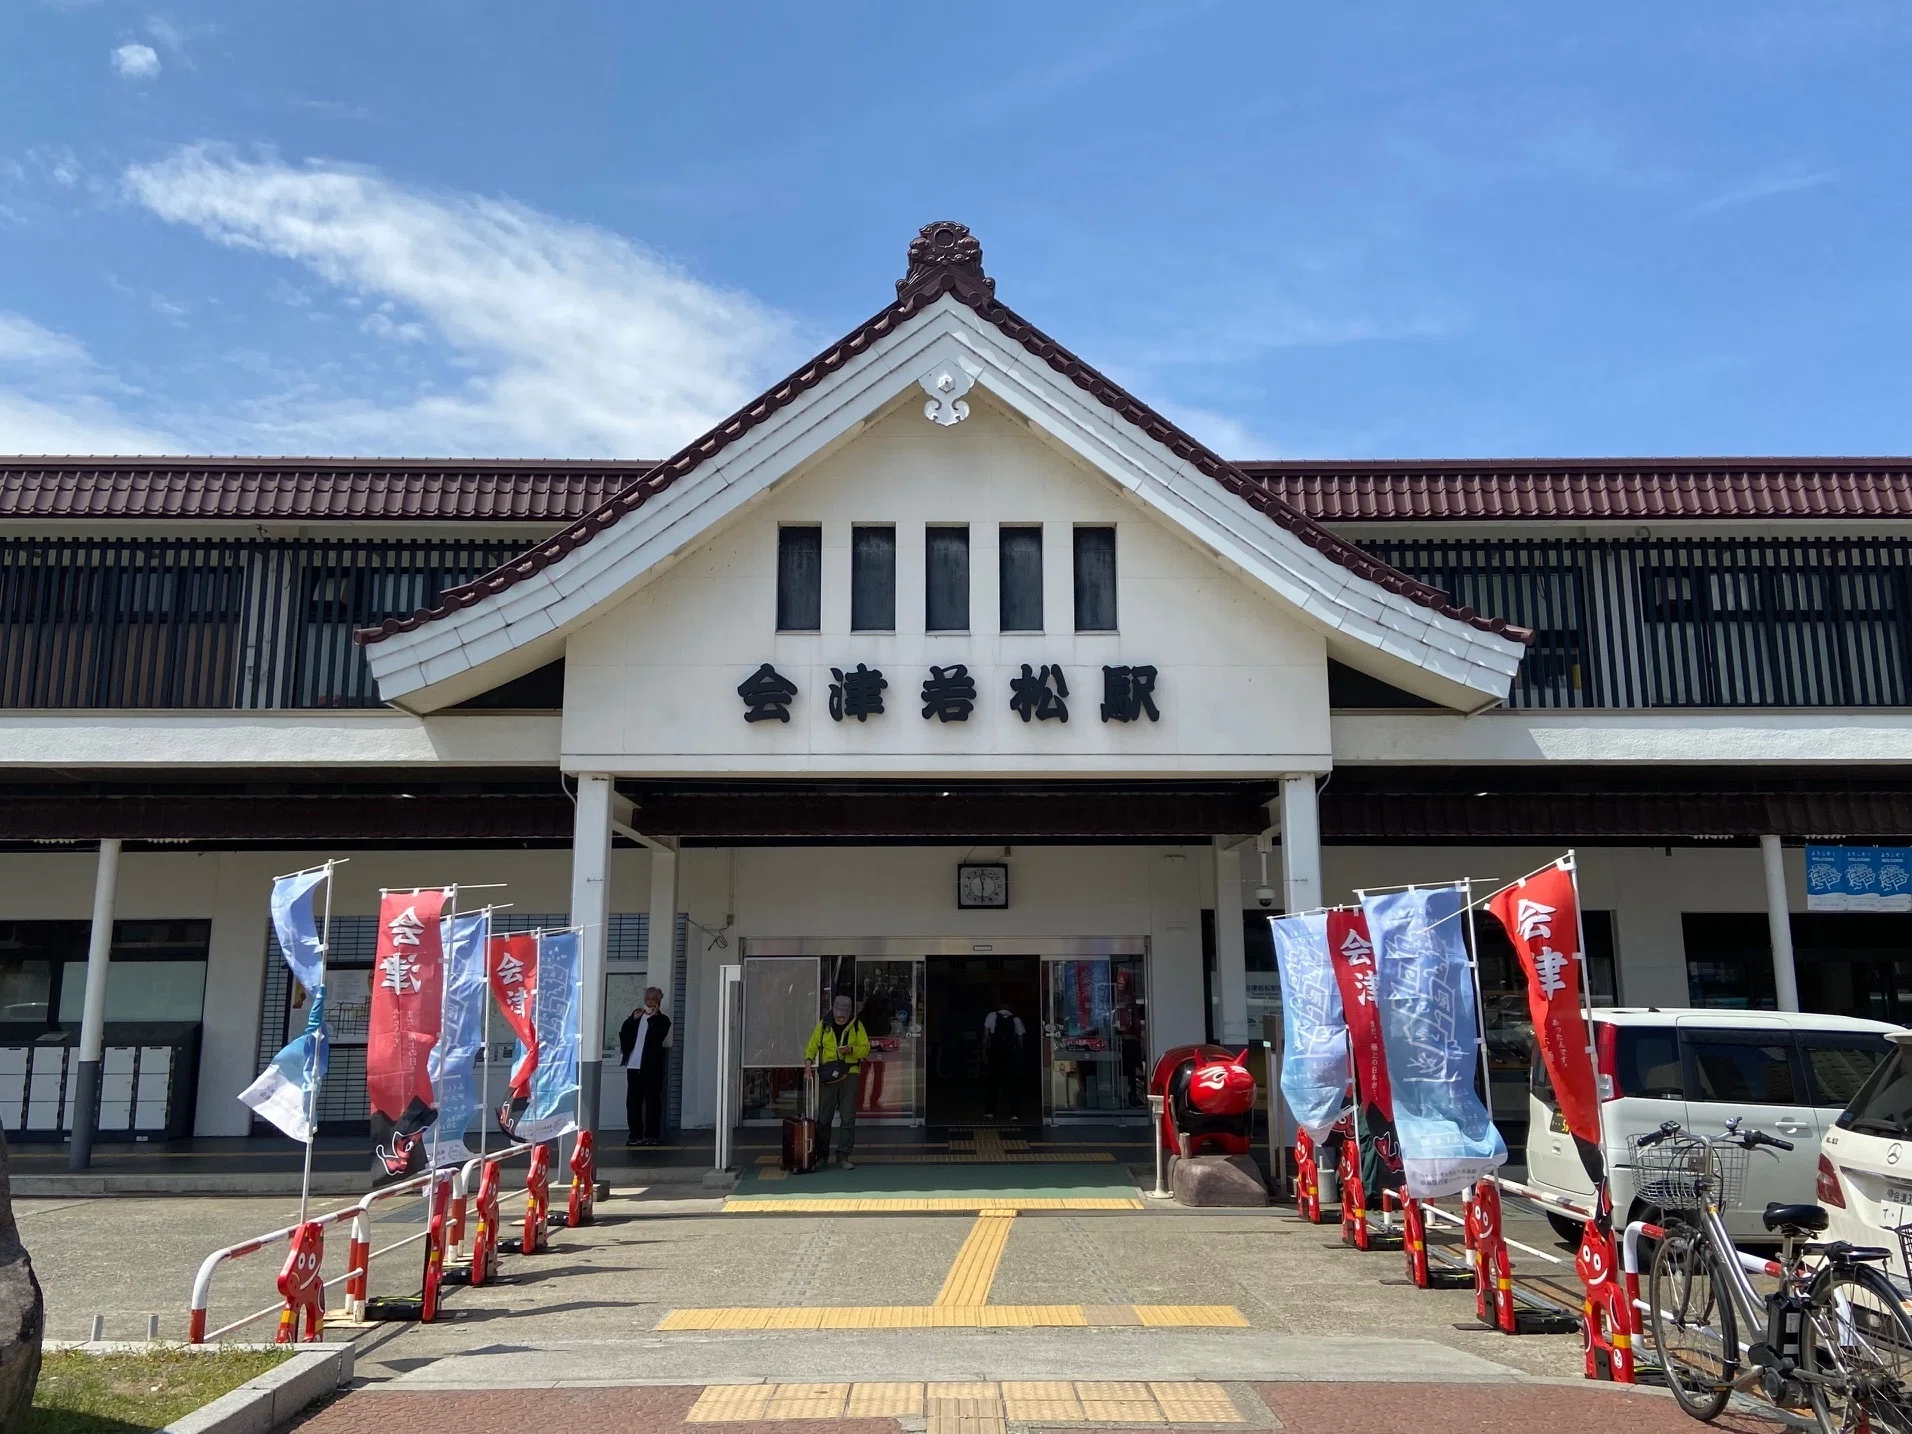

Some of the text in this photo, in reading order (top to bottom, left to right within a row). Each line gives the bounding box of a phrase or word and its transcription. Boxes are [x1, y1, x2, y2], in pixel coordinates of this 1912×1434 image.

[737, 662, 1160, 724] 会津若松駅
